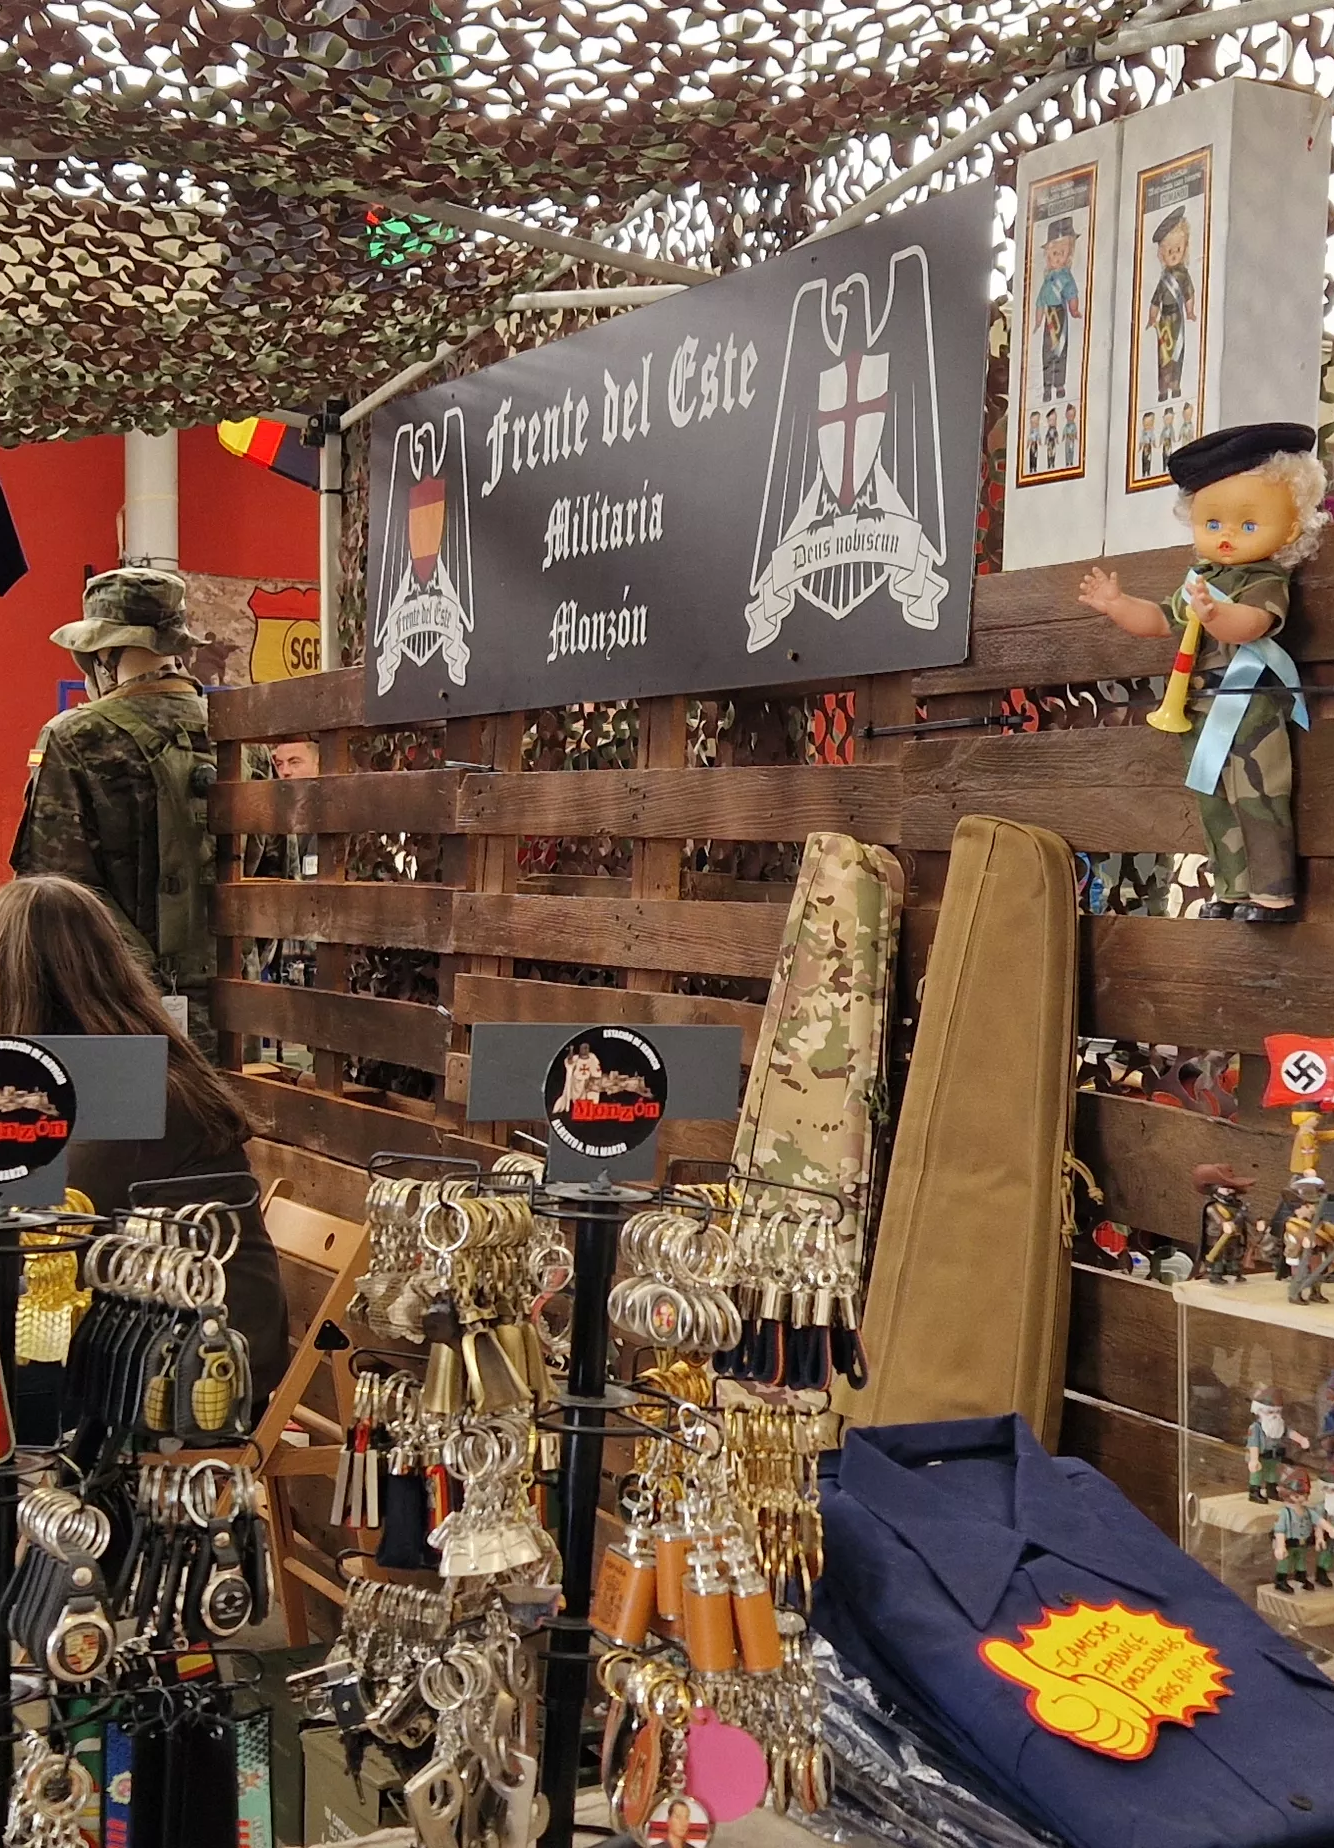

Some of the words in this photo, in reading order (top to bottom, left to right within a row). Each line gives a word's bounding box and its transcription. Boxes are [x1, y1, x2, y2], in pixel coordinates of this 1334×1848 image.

[481, 387, 590, 499] Frente
[602, 351, 654, 448] del
[668, 332, 759, 429] Este
[542, 479, 664, 573] Militaria
[792, 535, 832, 572] Deus
[395, 609, 420, 641] Frente
[421, 601, 433, 625] del
[434, 599, 452, 629] Este
[547, 585, 649, 665] Monzón
[572, 1097, 660, 1122] Monzón
